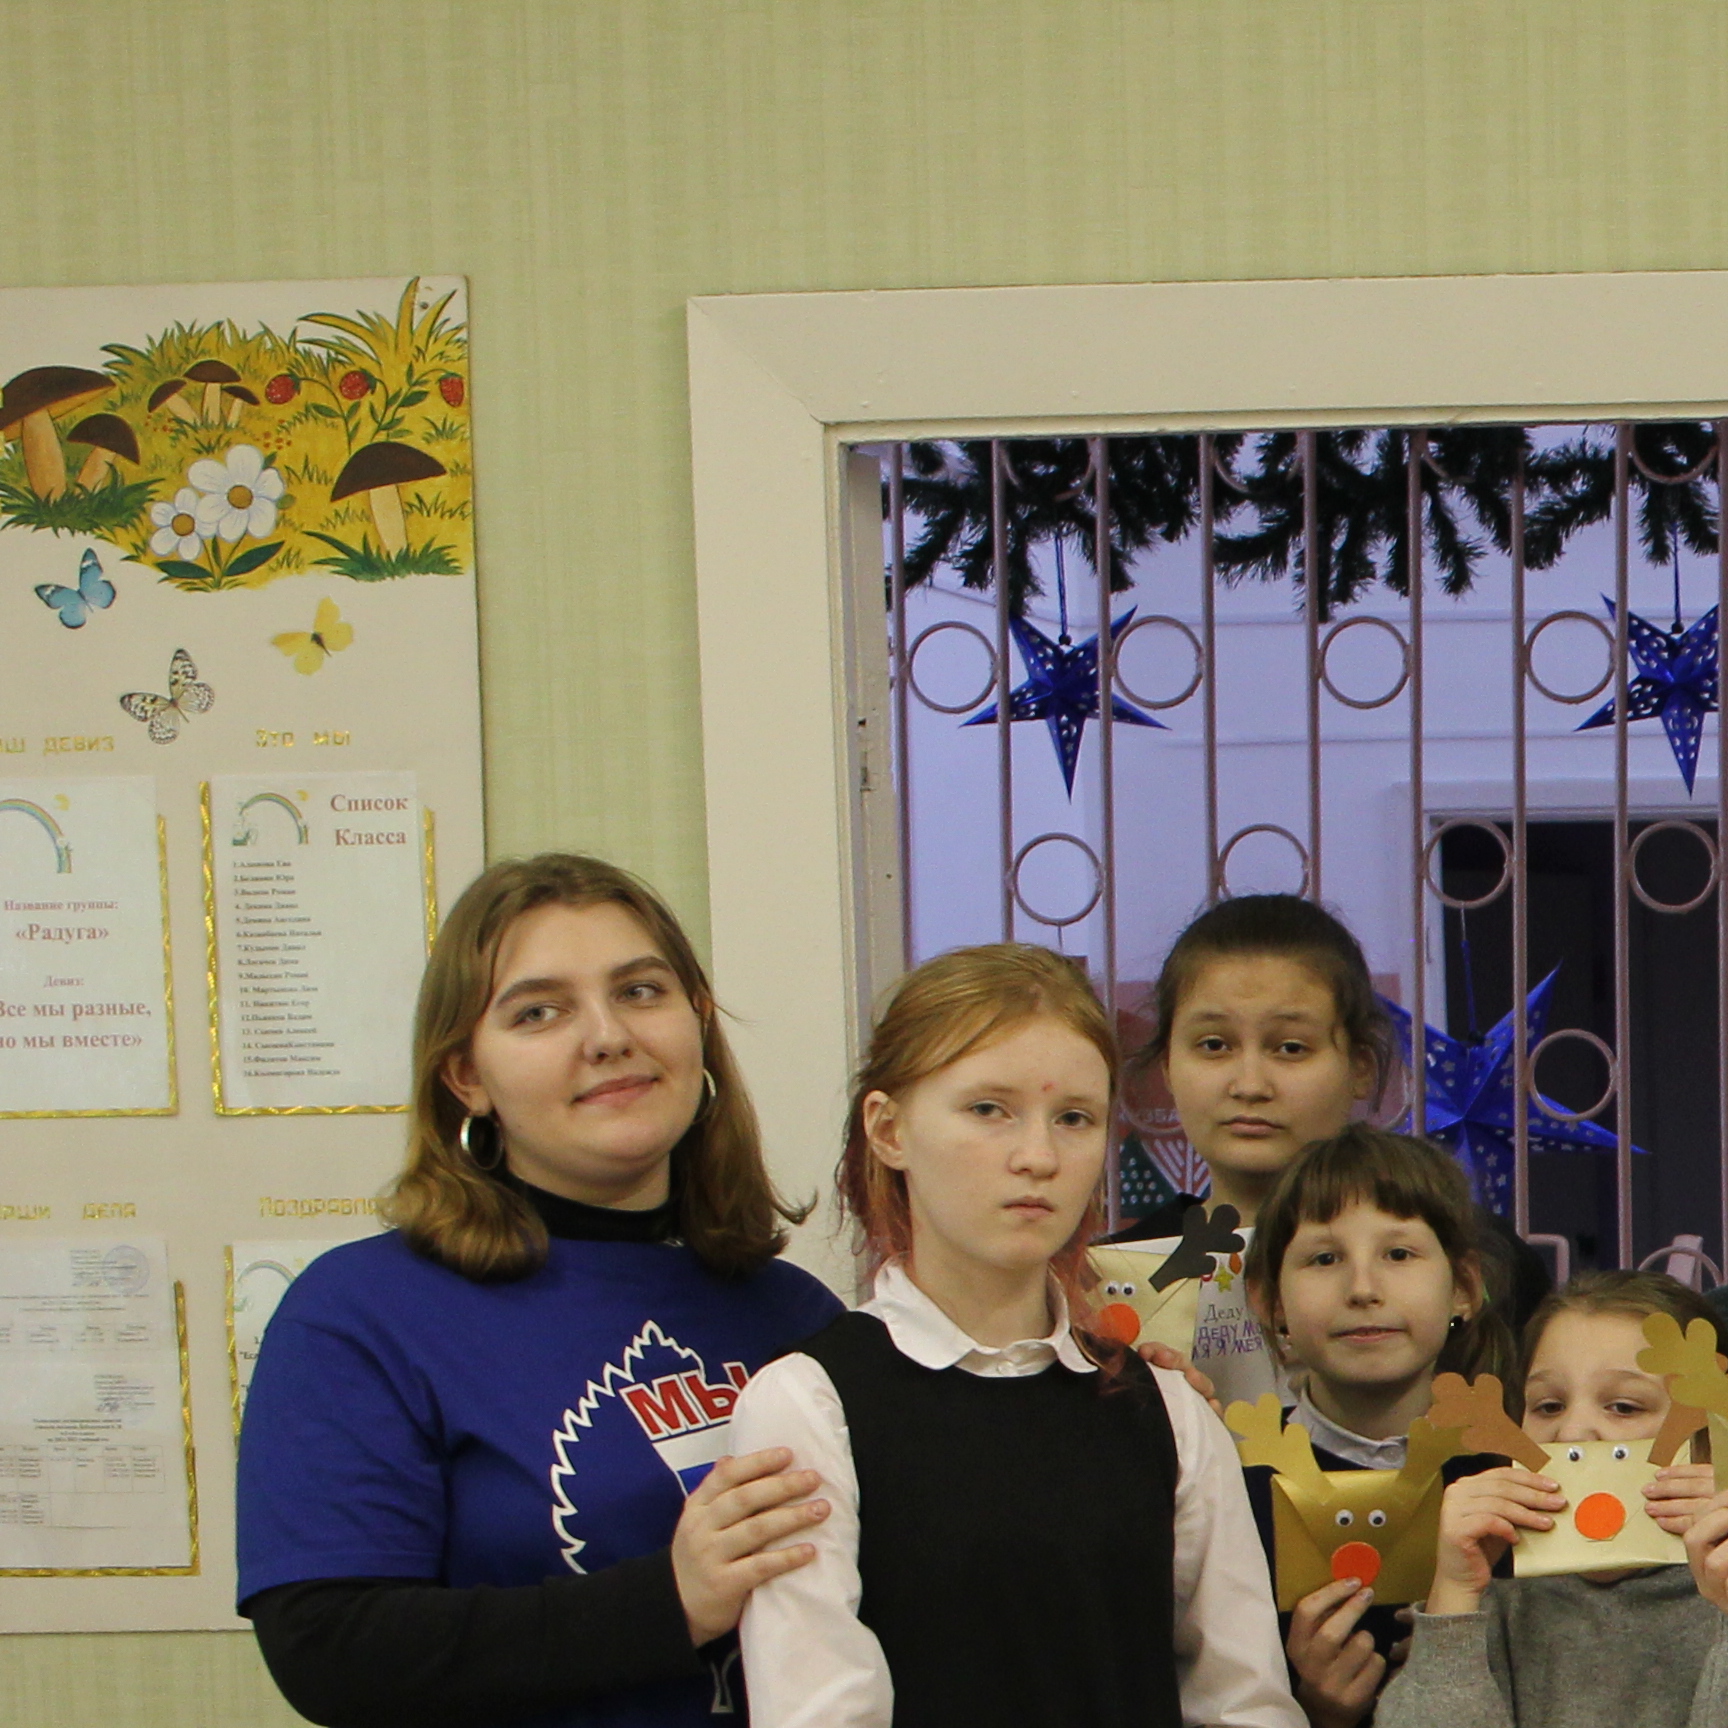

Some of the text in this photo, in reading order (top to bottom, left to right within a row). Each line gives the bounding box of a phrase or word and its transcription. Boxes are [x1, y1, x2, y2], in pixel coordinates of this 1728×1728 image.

[43, 736, 115, 756] ДЕВИЗ
[330, 794, 408, 812] Список
[335, 830, 407, 848] Класса
[16, 923, 109, 945] «Радуга»
[33, 1002, 65, 1017] мы
[71, 1001, 152, 1022] разные,
[23, 1036, 55, 1049] мы
[62, 1034, 142, 1049] вместе»
